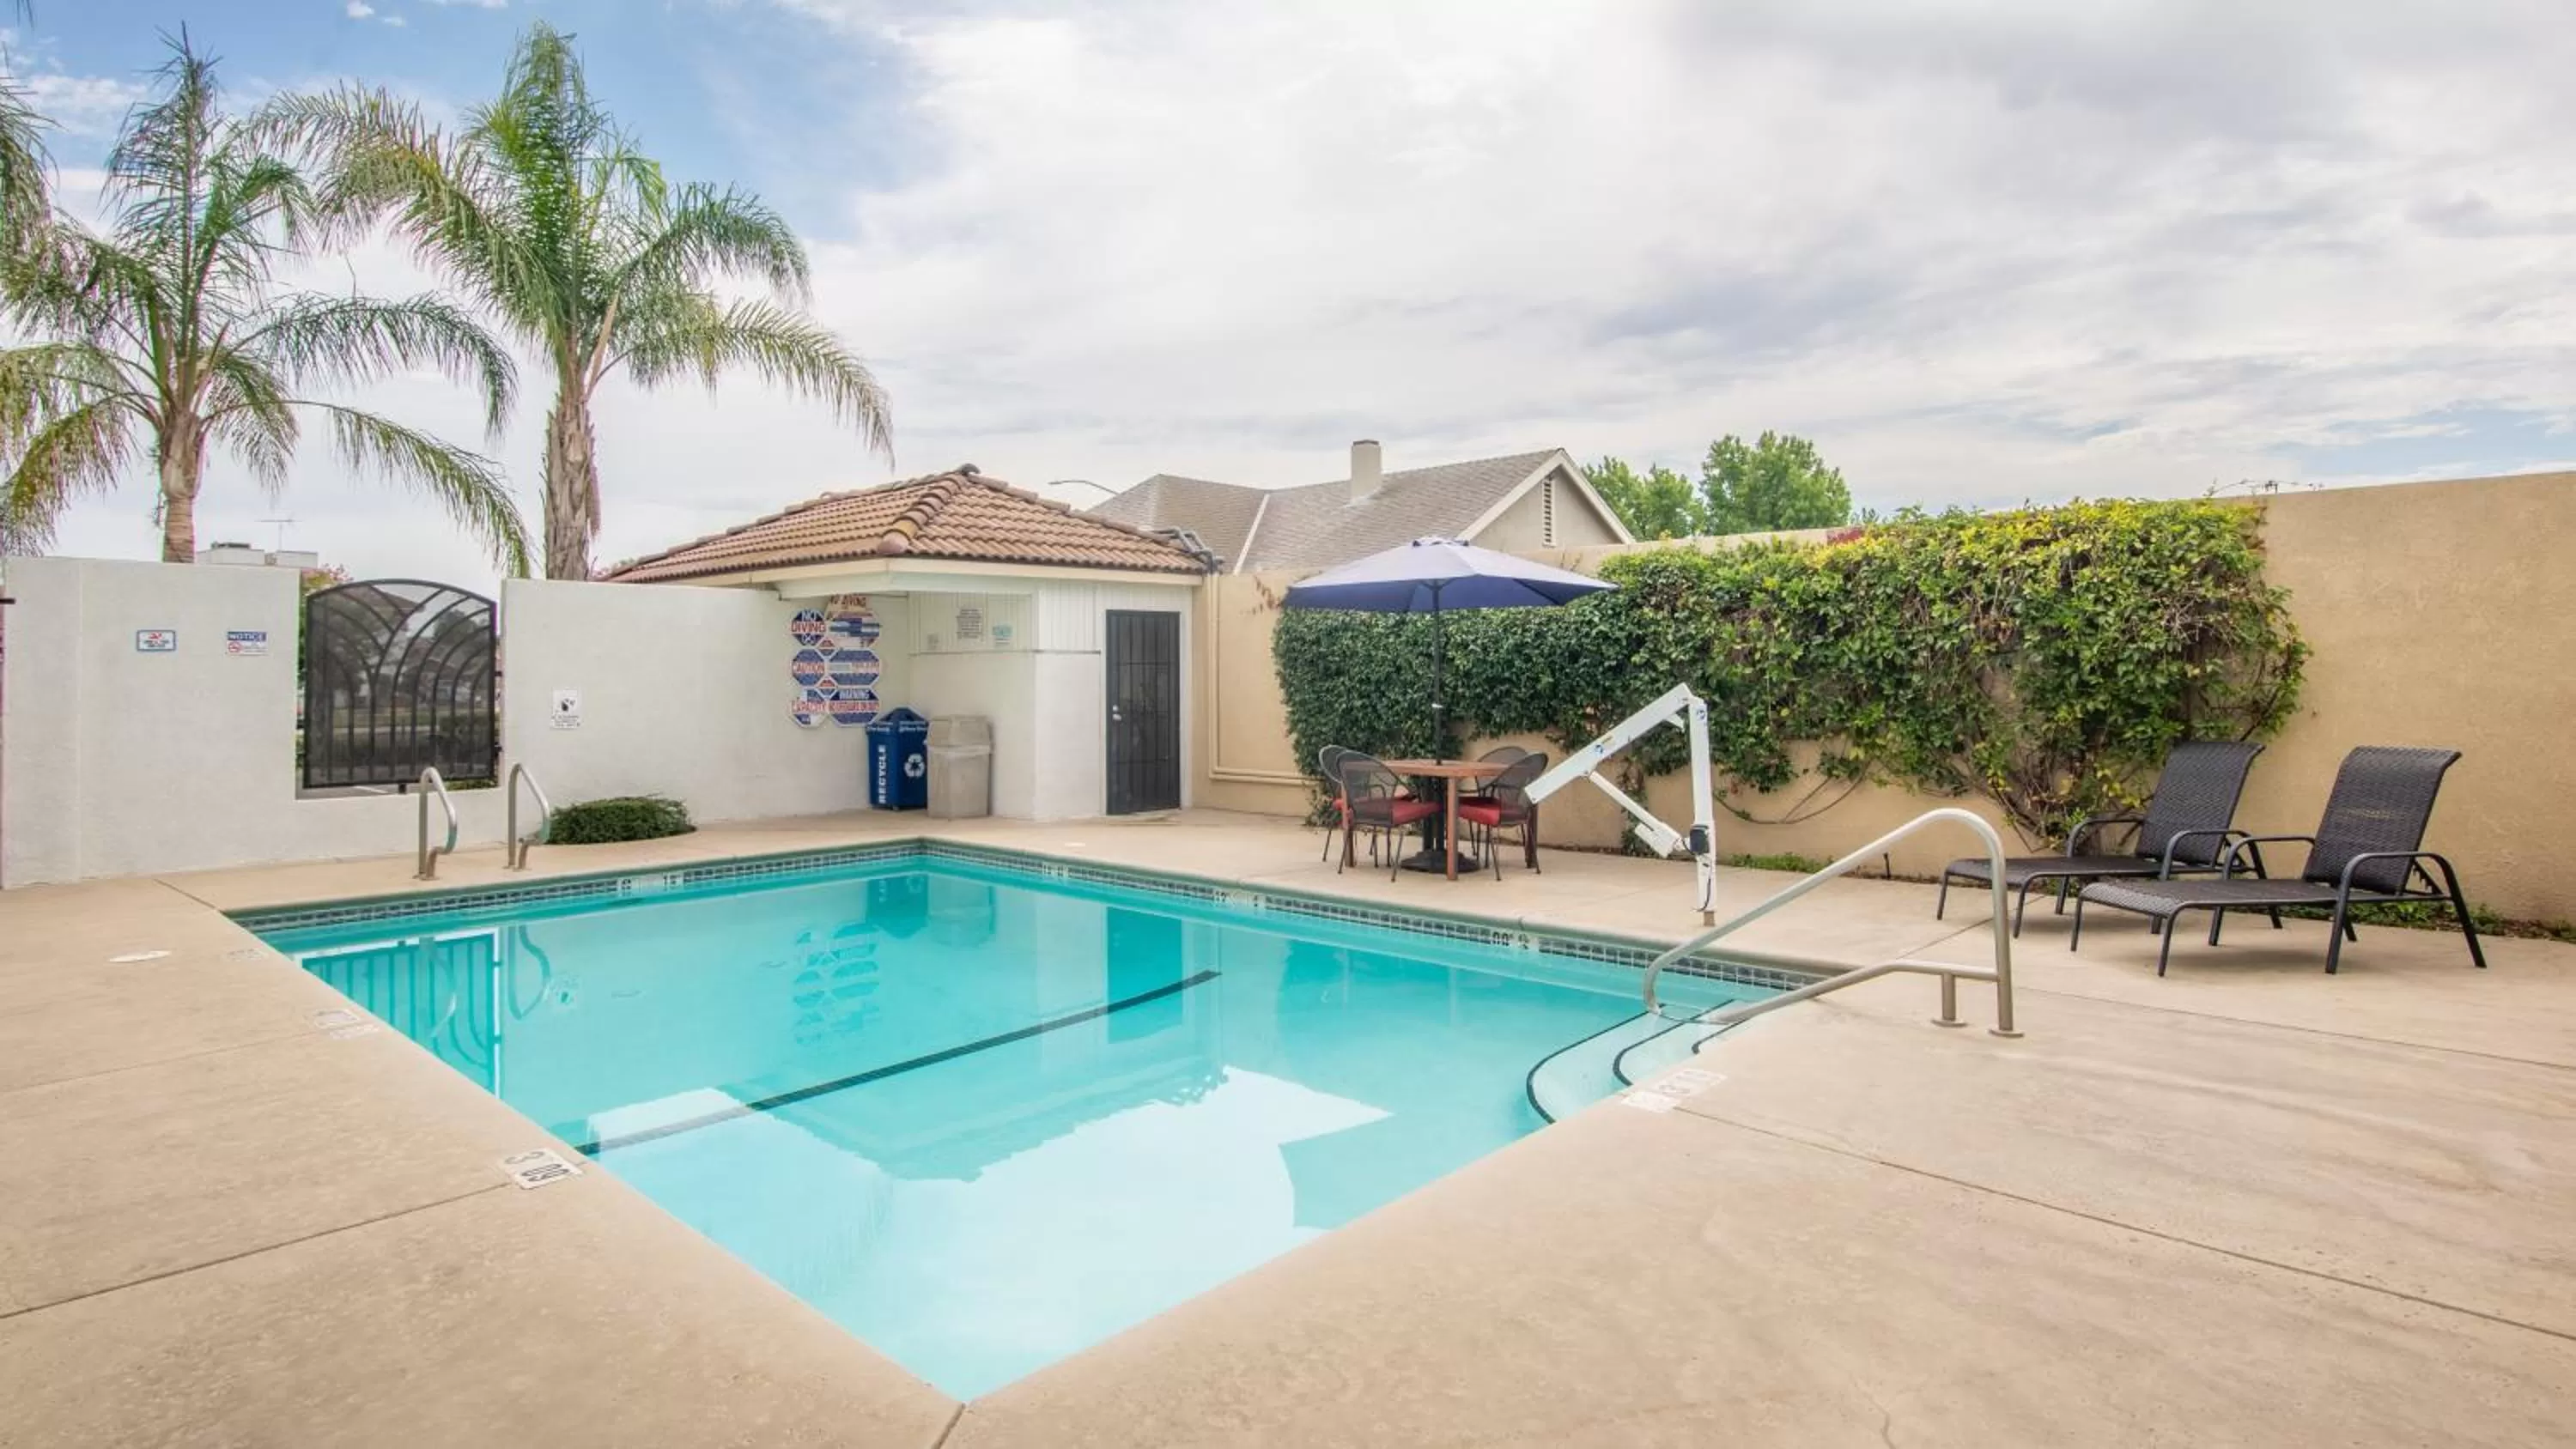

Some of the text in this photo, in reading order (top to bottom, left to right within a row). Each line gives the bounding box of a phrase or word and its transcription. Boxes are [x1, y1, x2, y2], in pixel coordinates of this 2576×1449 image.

[801, 609, 818, 621] NO
[791, 621, 826, 633] DIVING
[228, 632, 266, 641] NOTICE
[878, 744, 887, 804] RECYCLE
